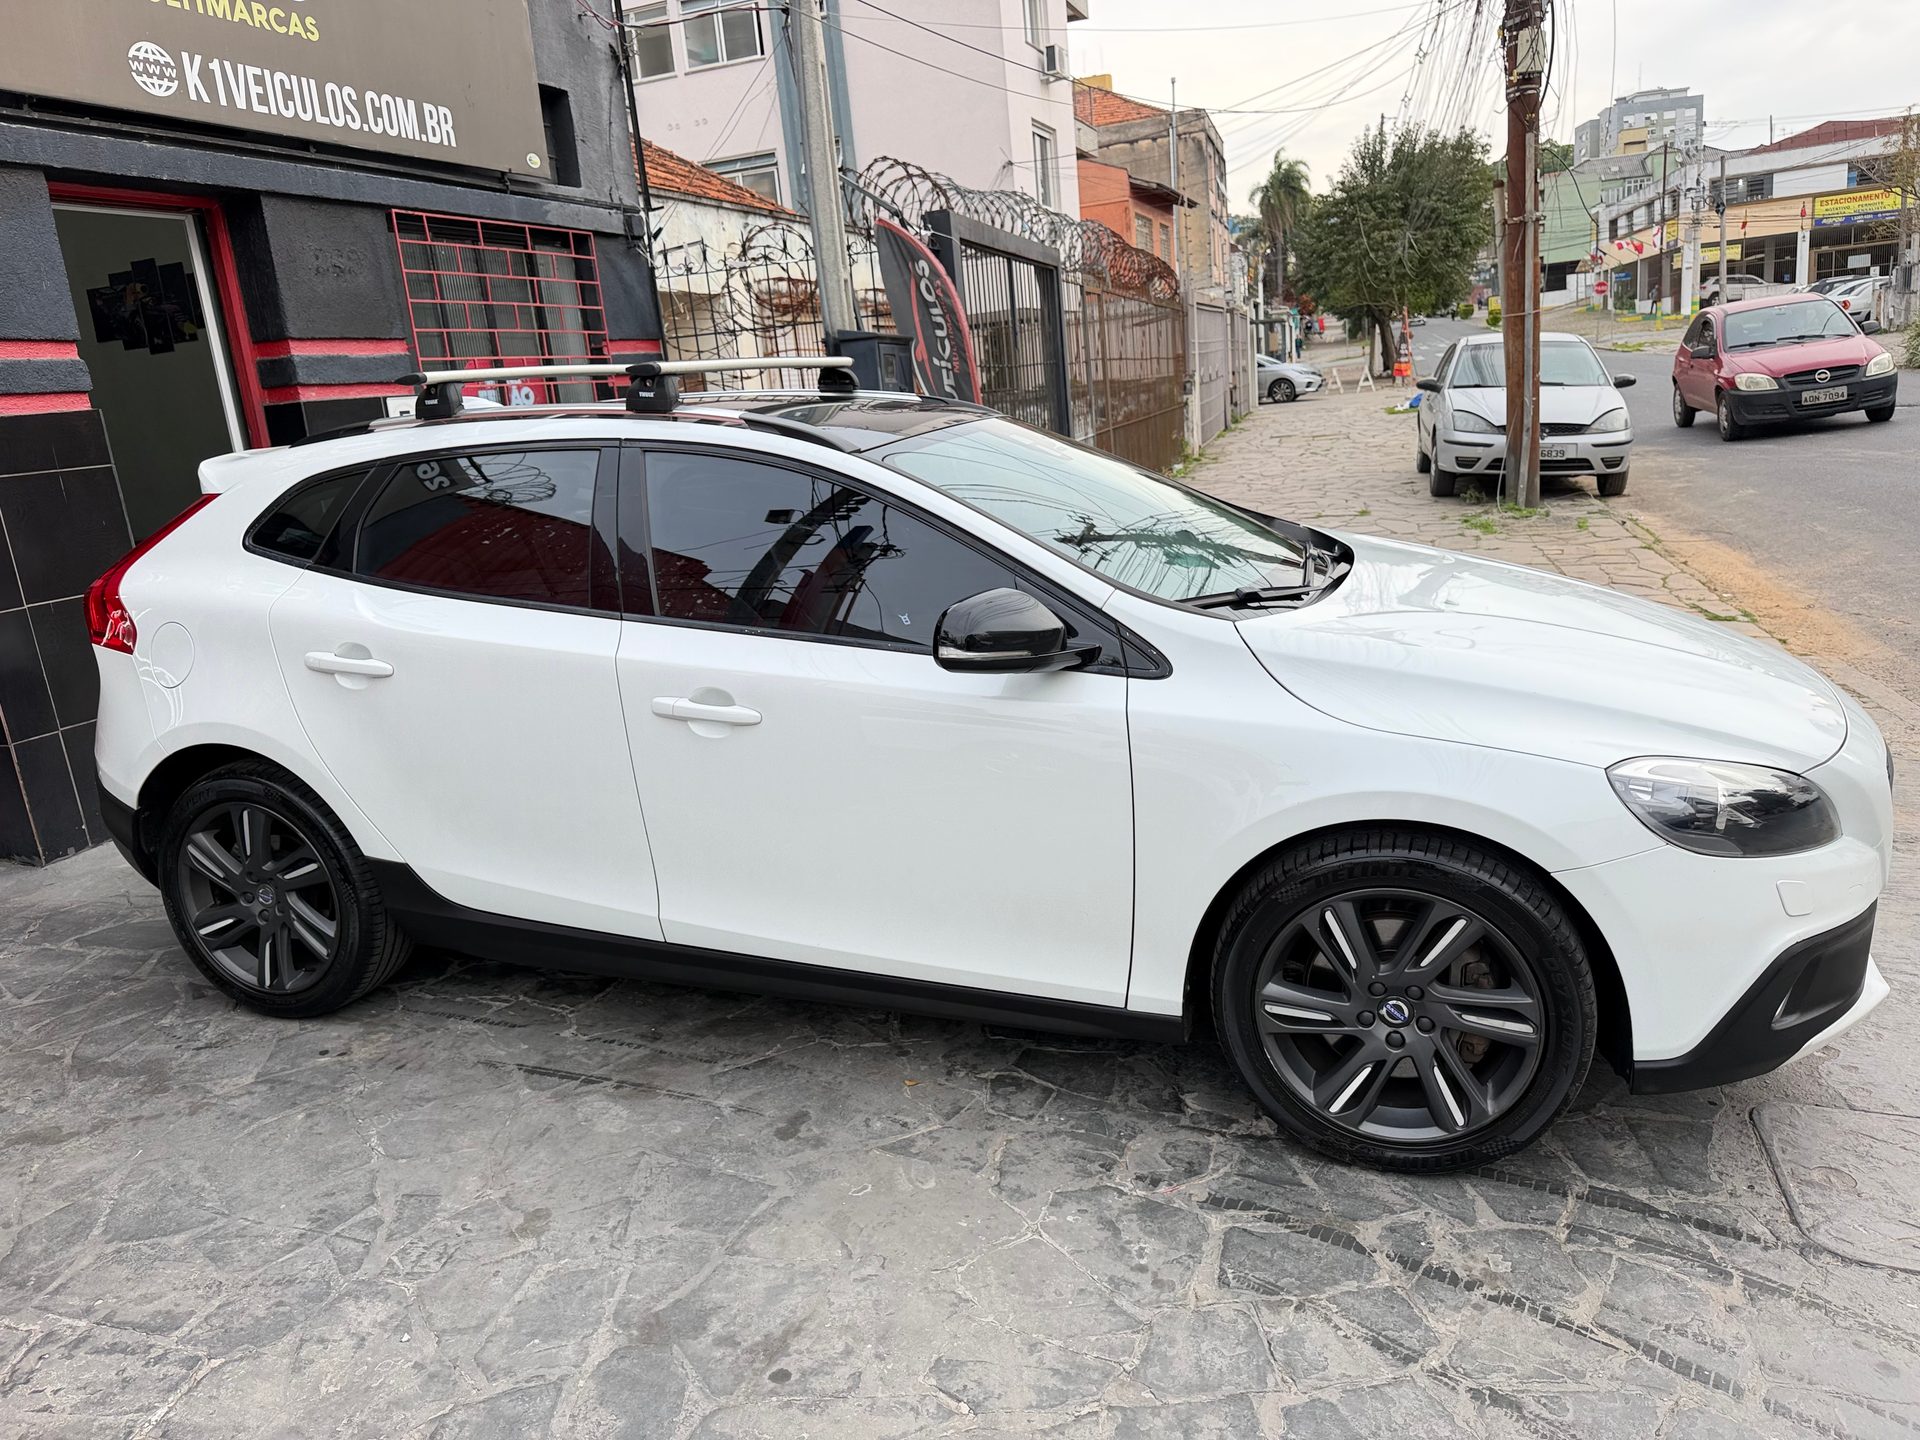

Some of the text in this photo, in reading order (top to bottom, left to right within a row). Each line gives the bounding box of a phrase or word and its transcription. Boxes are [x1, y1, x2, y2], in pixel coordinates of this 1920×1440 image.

[150, 0, 320, 42] IMARCAS
[180, 50, 457, 148] K1VEICULOS.COM.BR
[1820, 192, 1890, 207] ESTACIONAMENTO
[1541, 450, 1565, 458] 6839
